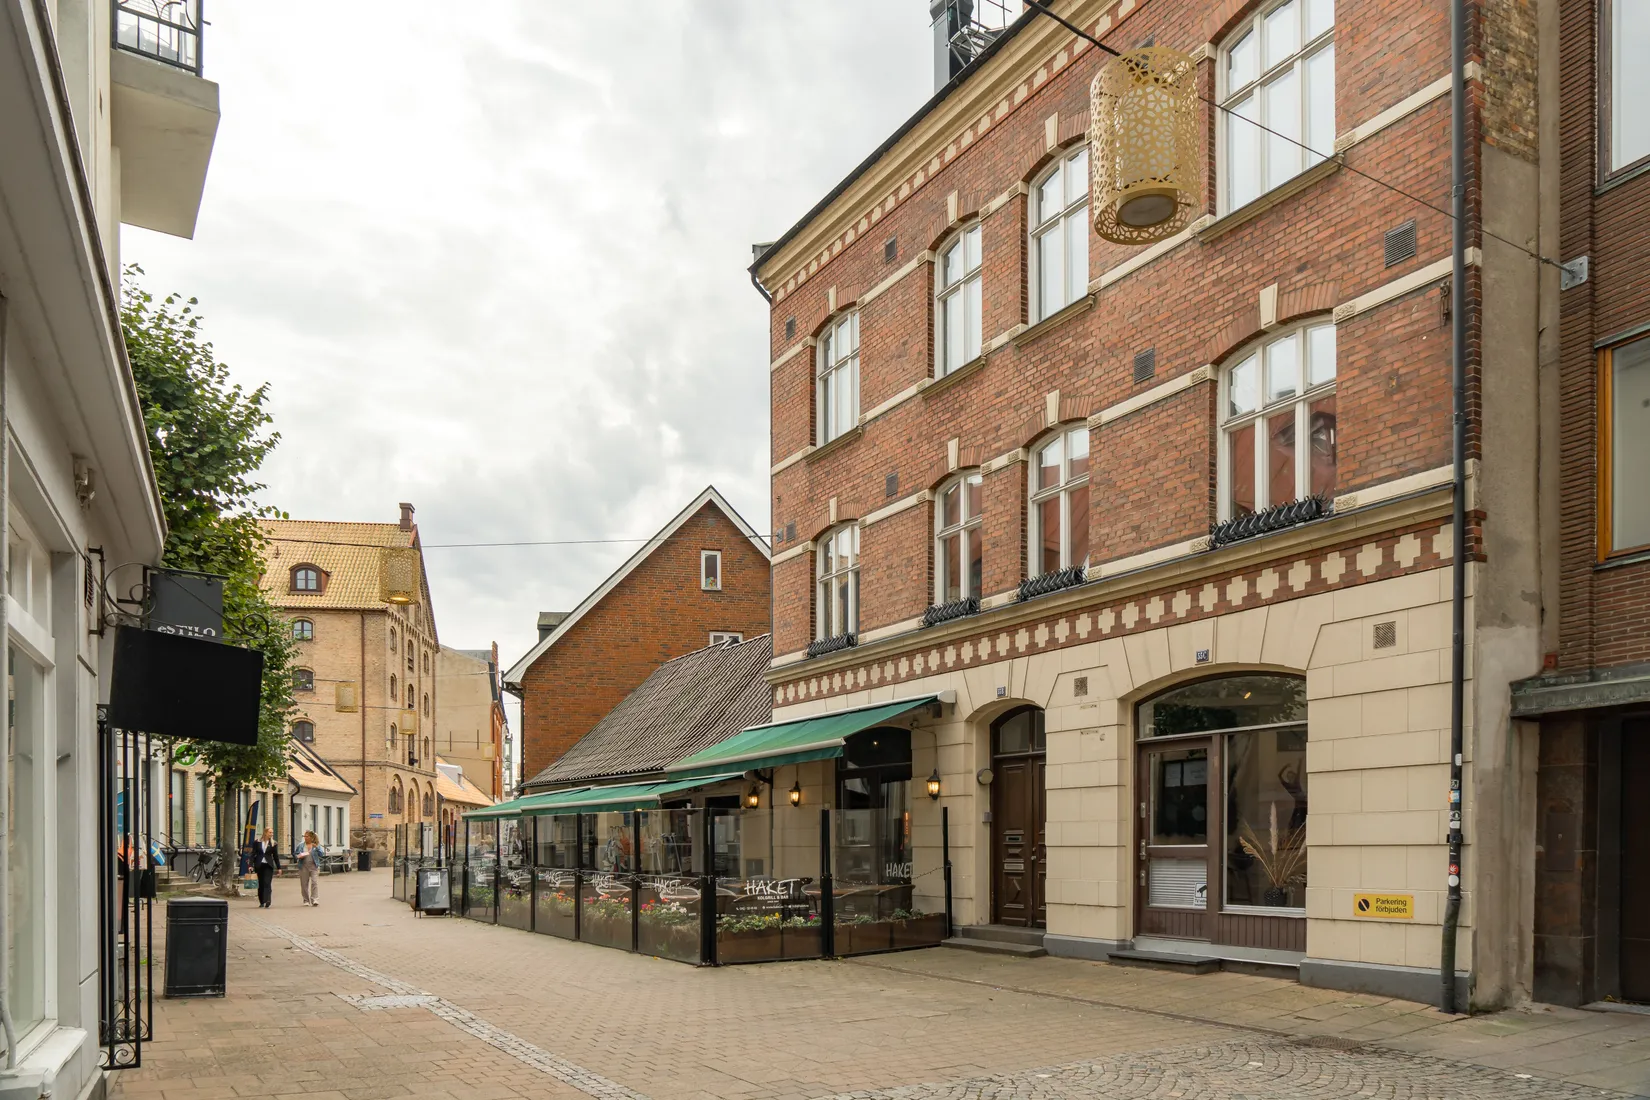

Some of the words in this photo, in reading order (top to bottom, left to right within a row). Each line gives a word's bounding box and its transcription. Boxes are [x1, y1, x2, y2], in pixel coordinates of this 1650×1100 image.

[744, 878, 800, 895] HAKET
[1376, 897, 1407, 907] Parkering
[1376, 905, 1407, 914] förbjuden
